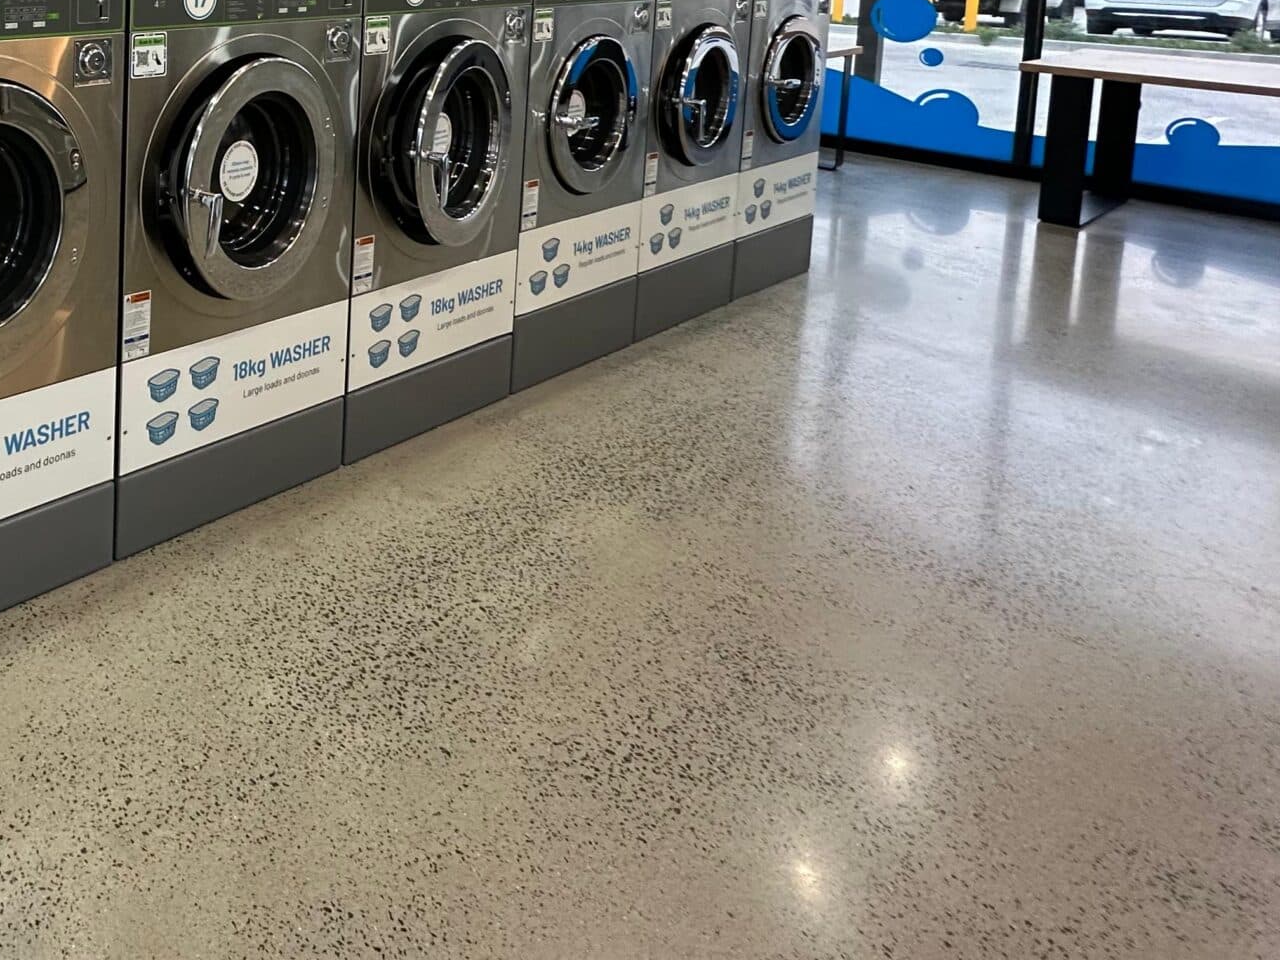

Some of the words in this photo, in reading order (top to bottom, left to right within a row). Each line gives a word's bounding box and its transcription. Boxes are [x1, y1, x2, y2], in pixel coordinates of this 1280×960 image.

[595, 227, 631, 248] WASHER
[430, 297, 456, 316] 18kg
[457, 278, 503, 306] WASHER
[232, 357, 266, 381] 18kg
[270, 335, 331, 369] WASHER
[243, 386, 263, 399] Large
[264, 379, 282, 391] loads
[283, 374, 296, 386] and
[297, 367, 320, 380] doonas
[3, 410, 91, 456] WASHER
[24, 457, 42, 473] and
[43, 449, 76, 468] doonas
